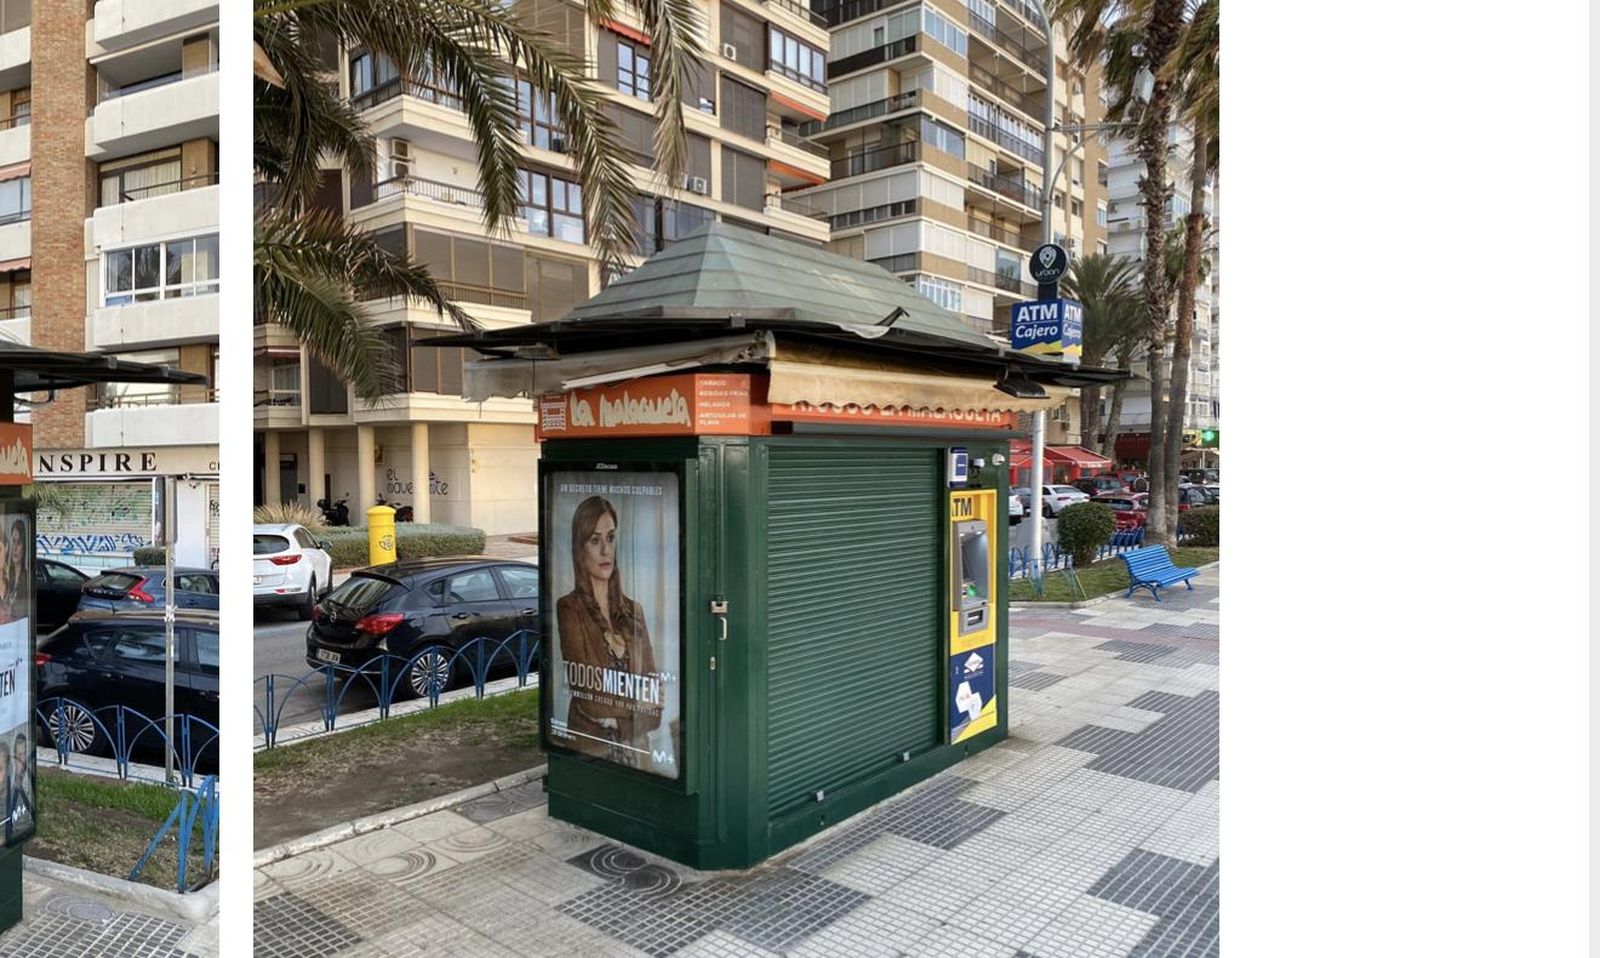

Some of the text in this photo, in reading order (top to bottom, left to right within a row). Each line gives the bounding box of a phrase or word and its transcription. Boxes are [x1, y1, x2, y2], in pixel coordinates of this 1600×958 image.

[1017, 303, 1058, 322] ATM
[1064, 304, 1082, 322] ATM
[1015, 324, 1058, 340] Cajero
[951, 497, 973, 518] TM
